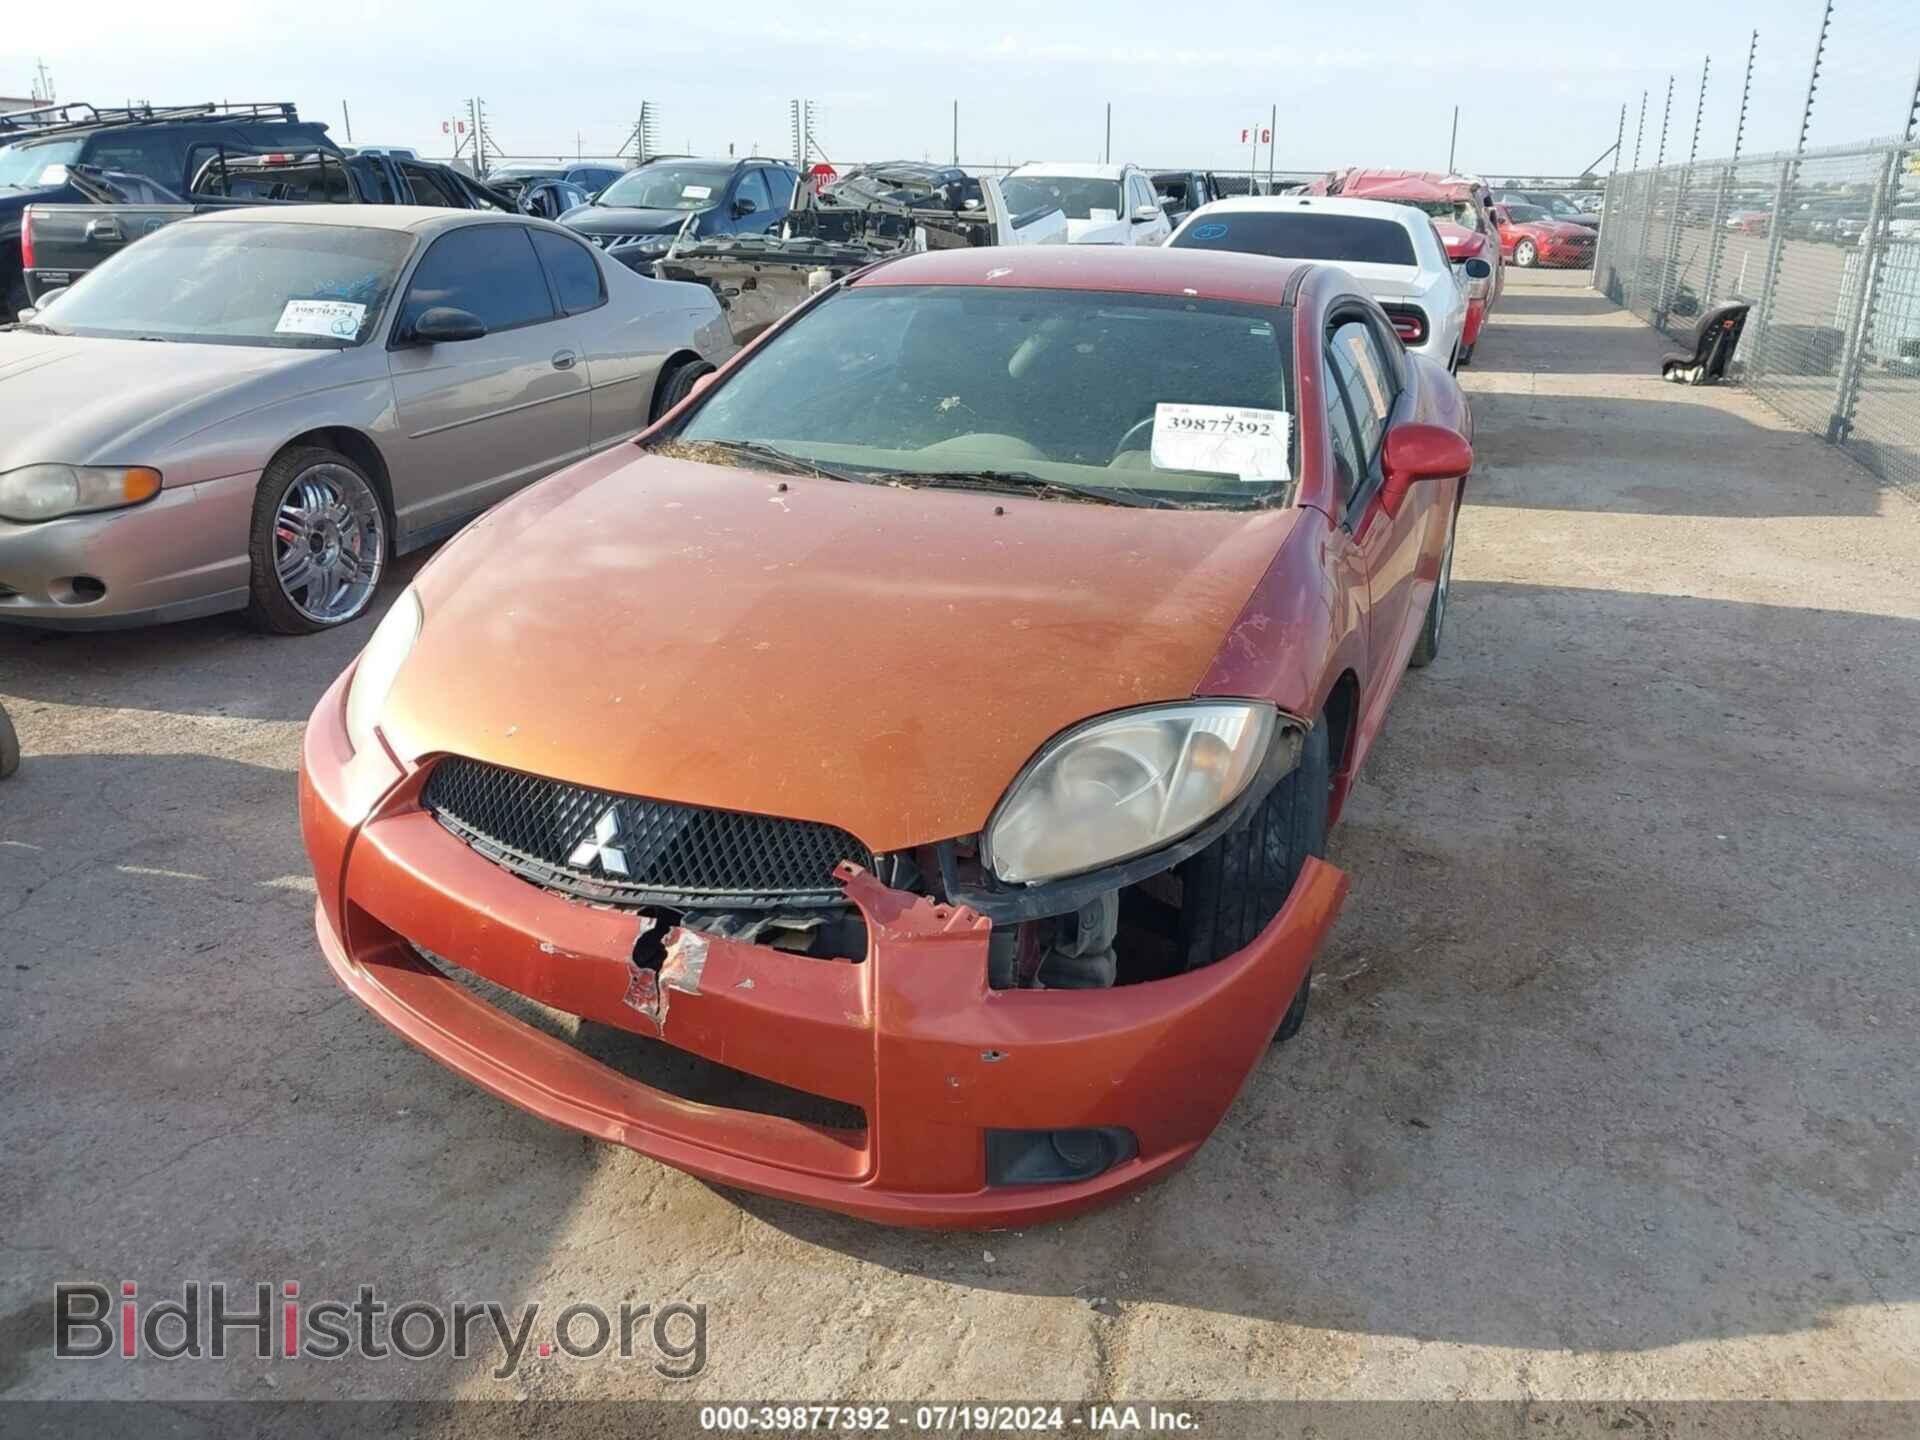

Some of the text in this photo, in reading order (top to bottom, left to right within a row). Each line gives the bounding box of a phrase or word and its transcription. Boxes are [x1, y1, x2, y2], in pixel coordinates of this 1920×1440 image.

[1241, 129, 1249, 144] F
[1261, 129, 1270, 144] G
[1167, 416, 1271, 437] 39877392
